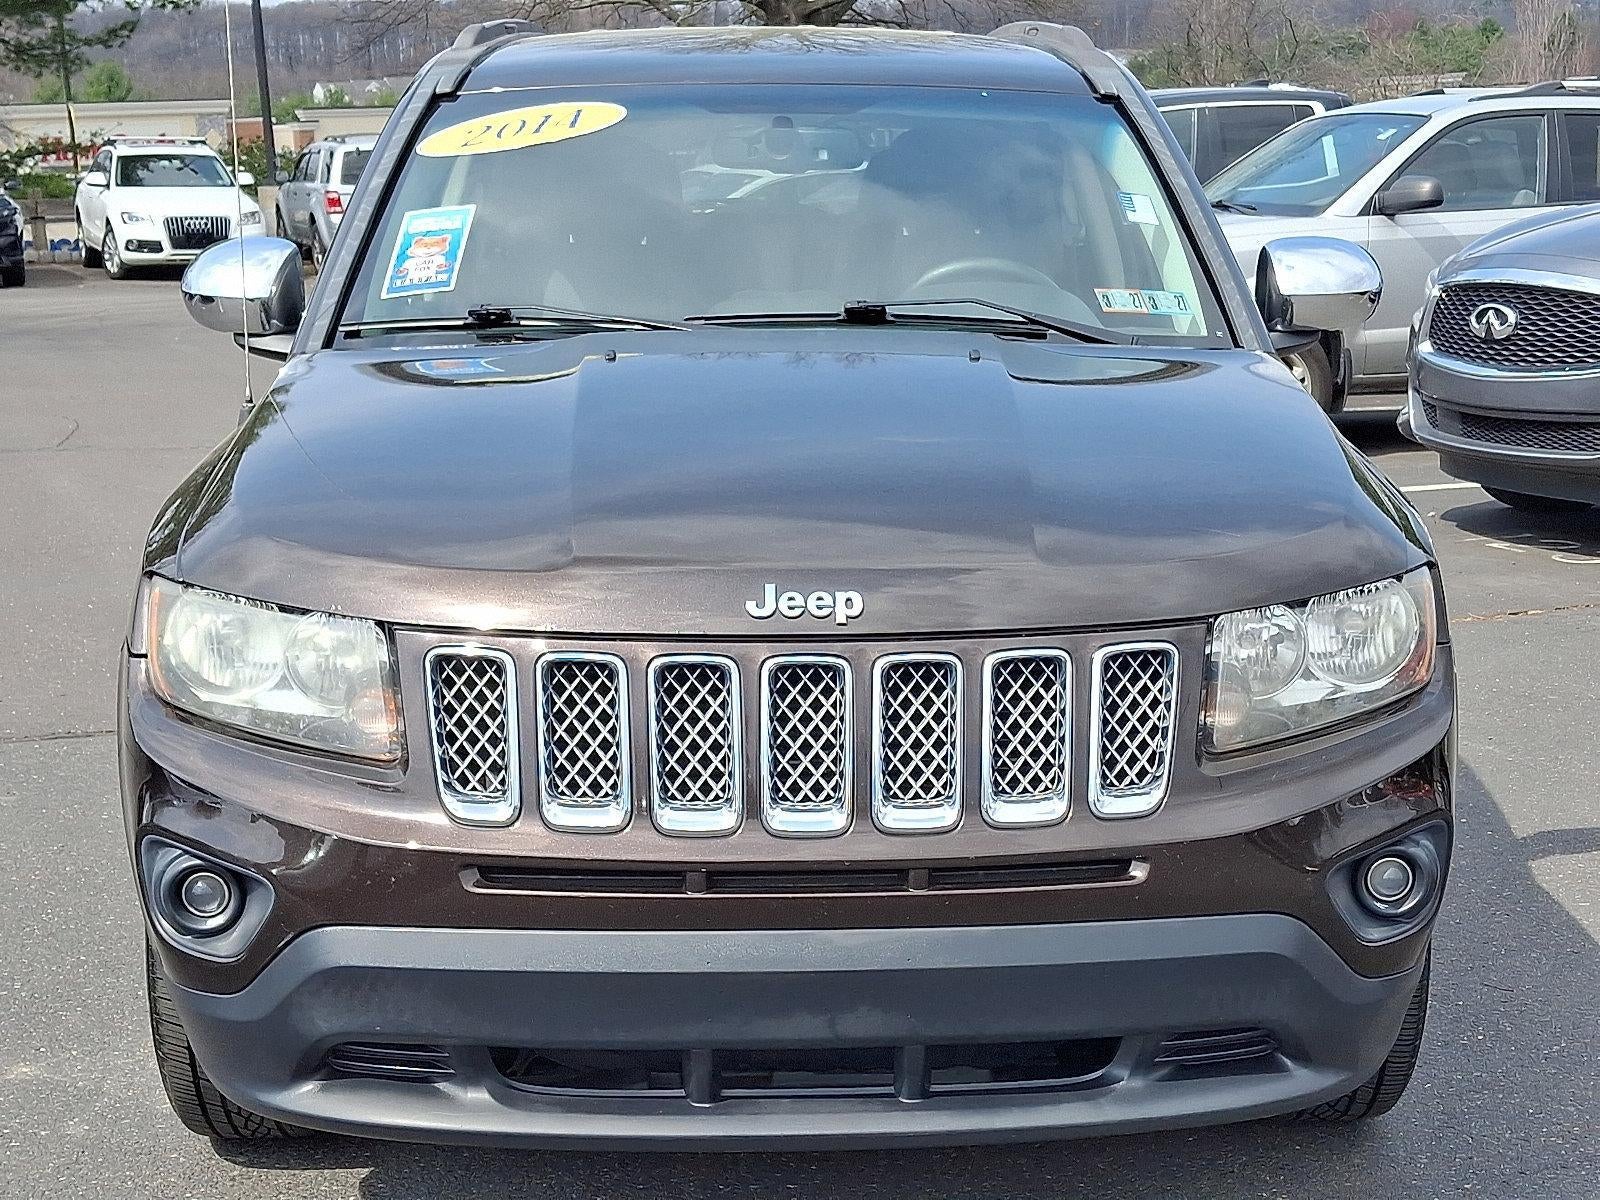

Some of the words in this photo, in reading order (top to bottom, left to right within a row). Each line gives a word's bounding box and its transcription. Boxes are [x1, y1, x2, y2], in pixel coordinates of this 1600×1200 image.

[460, 108, 583, 148] 2014
[1101, 293, 1112, 308] 3
[744, 583, 865, 626] Jeep
